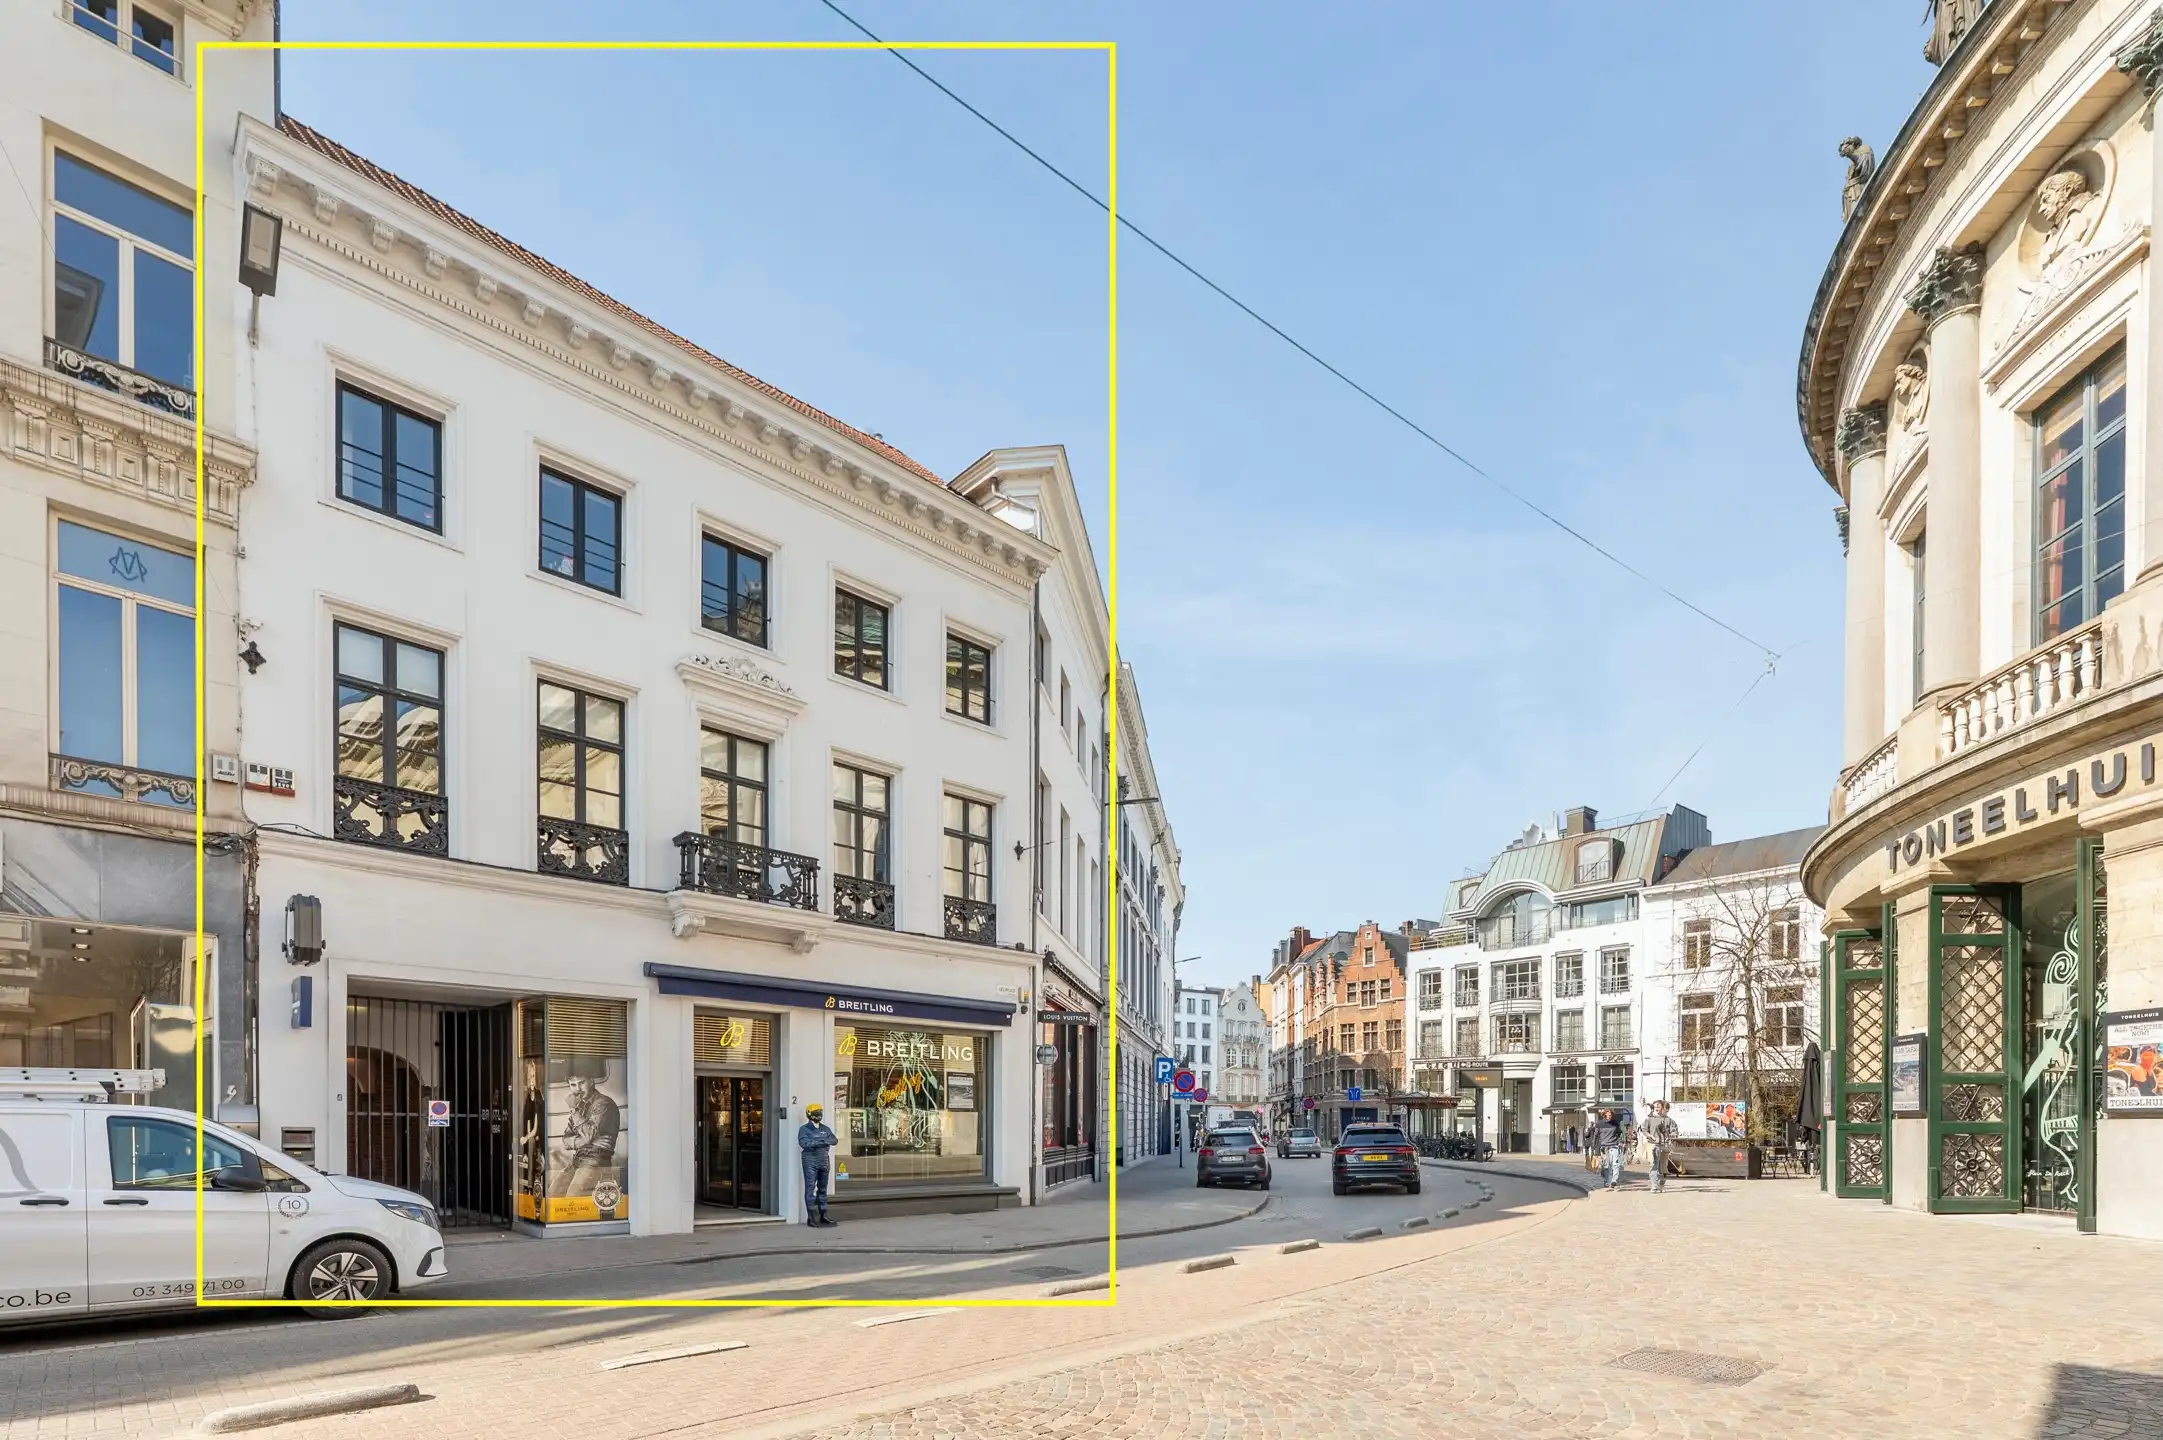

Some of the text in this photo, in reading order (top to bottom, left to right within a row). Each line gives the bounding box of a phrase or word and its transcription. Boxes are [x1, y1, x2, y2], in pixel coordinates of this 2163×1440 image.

[838, 1000, 894, 1013] BREITLING
[2121, 1012, 2159, 1020] TONEELHUIS
[867, 1040, 973, 1061] BREITLING
[1158, 1061, 1171, 1079] P
[792, 1096, 797, 1105] 2
[286, 1200, 301, 1209] 10
[132, 1279, 244, 1298] 03 349 71 00
